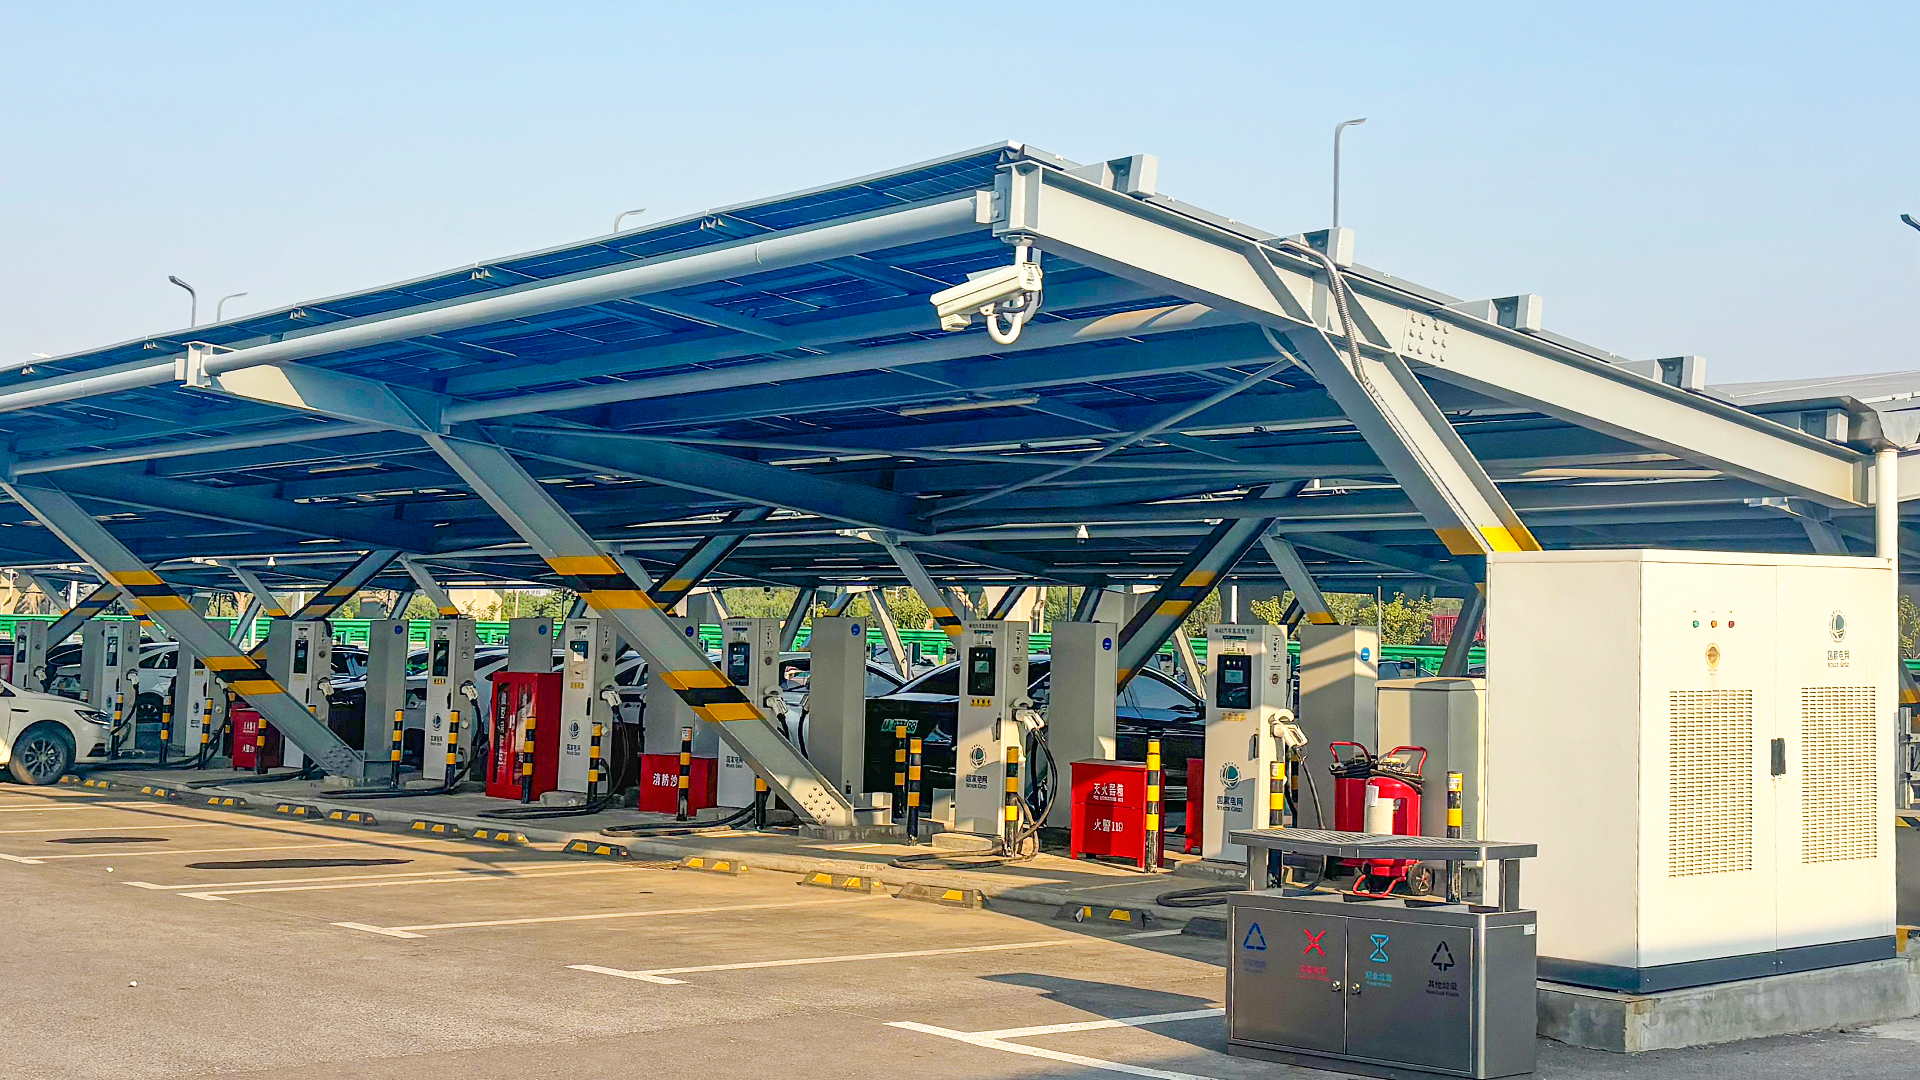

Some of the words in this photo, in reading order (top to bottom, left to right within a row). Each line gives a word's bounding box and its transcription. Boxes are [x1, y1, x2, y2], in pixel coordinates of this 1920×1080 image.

[652, 773, 679, 788] 消防沙
[1093, 782, 1124, 797] 灭火器箱
[1428, 979, 1458, 991] 其他垃圾
